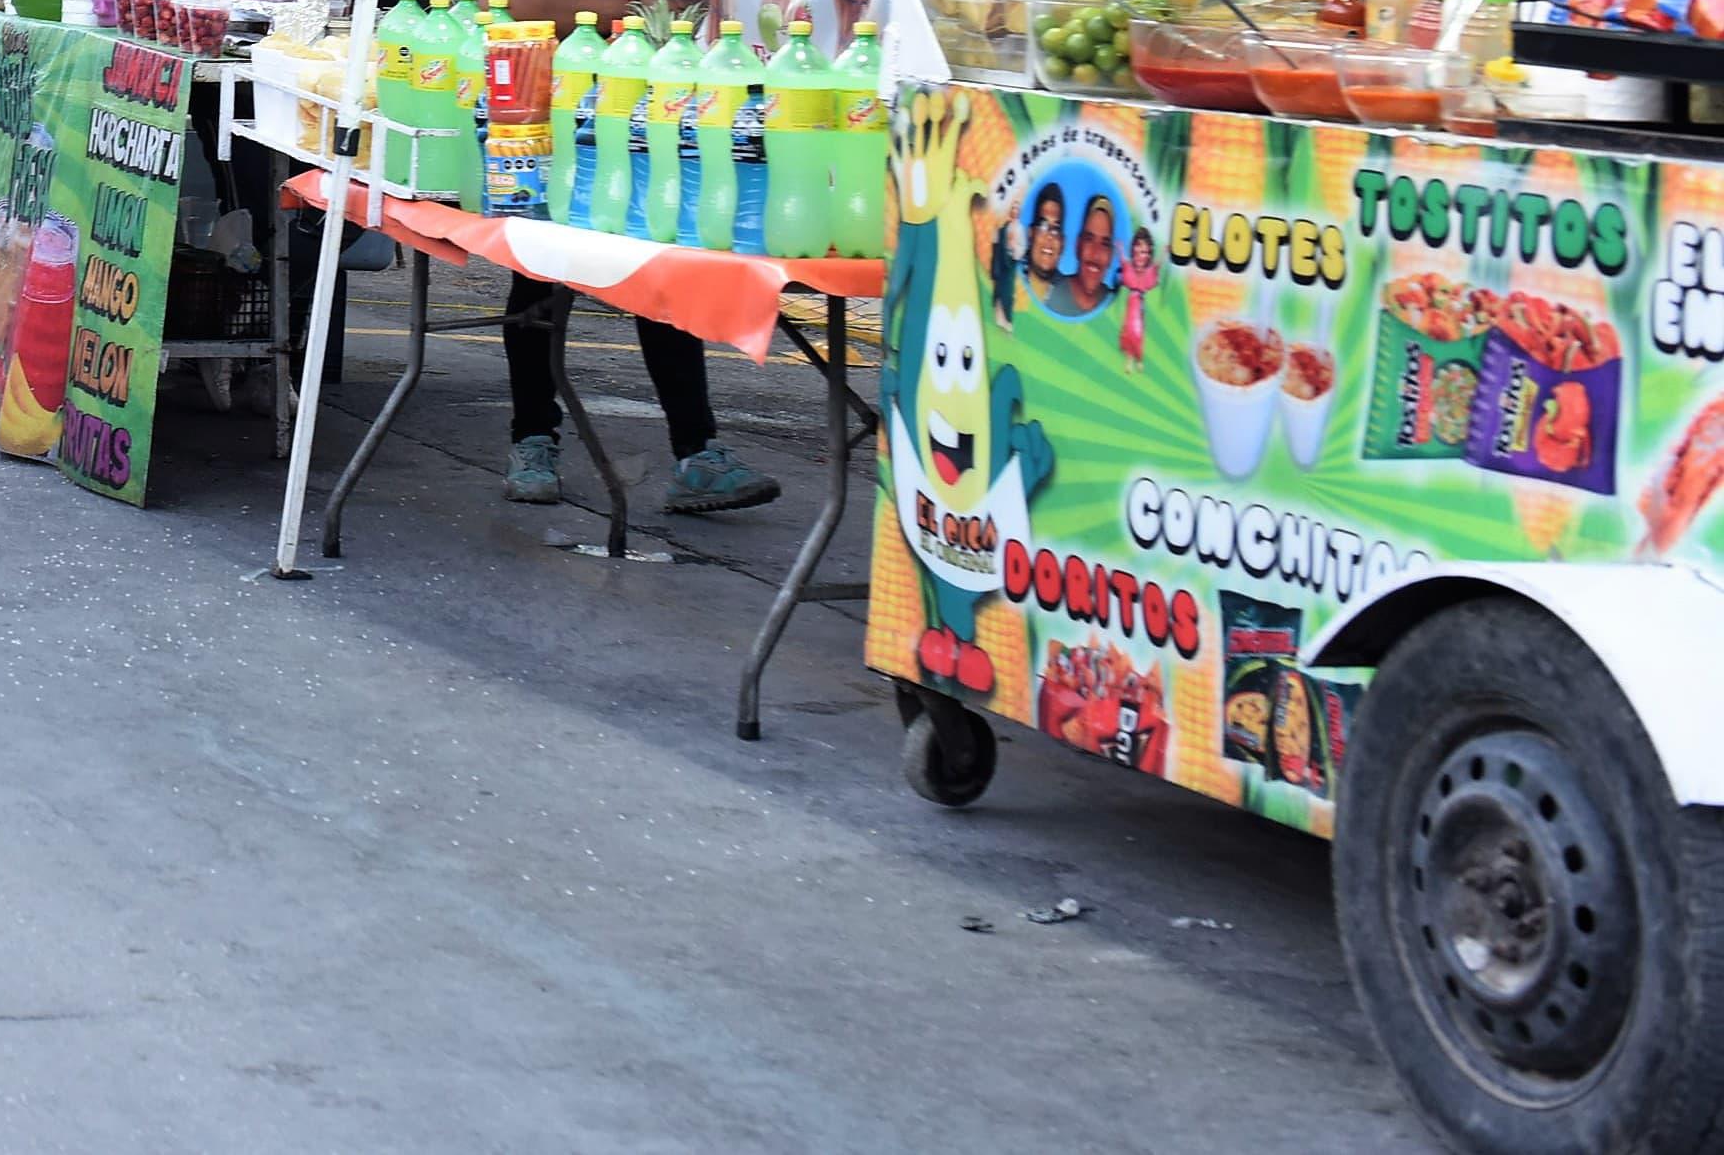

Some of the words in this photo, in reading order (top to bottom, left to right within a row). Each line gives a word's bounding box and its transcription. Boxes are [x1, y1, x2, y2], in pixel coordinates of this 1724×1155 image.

[1169, 202, 1347, 290] ELOTES
[1352, 169, 1630, 277] TOSTITOS
[1004, 531, 1199, 660] DORITOS
[1127, 477, 1433, 604] CONCHITA
